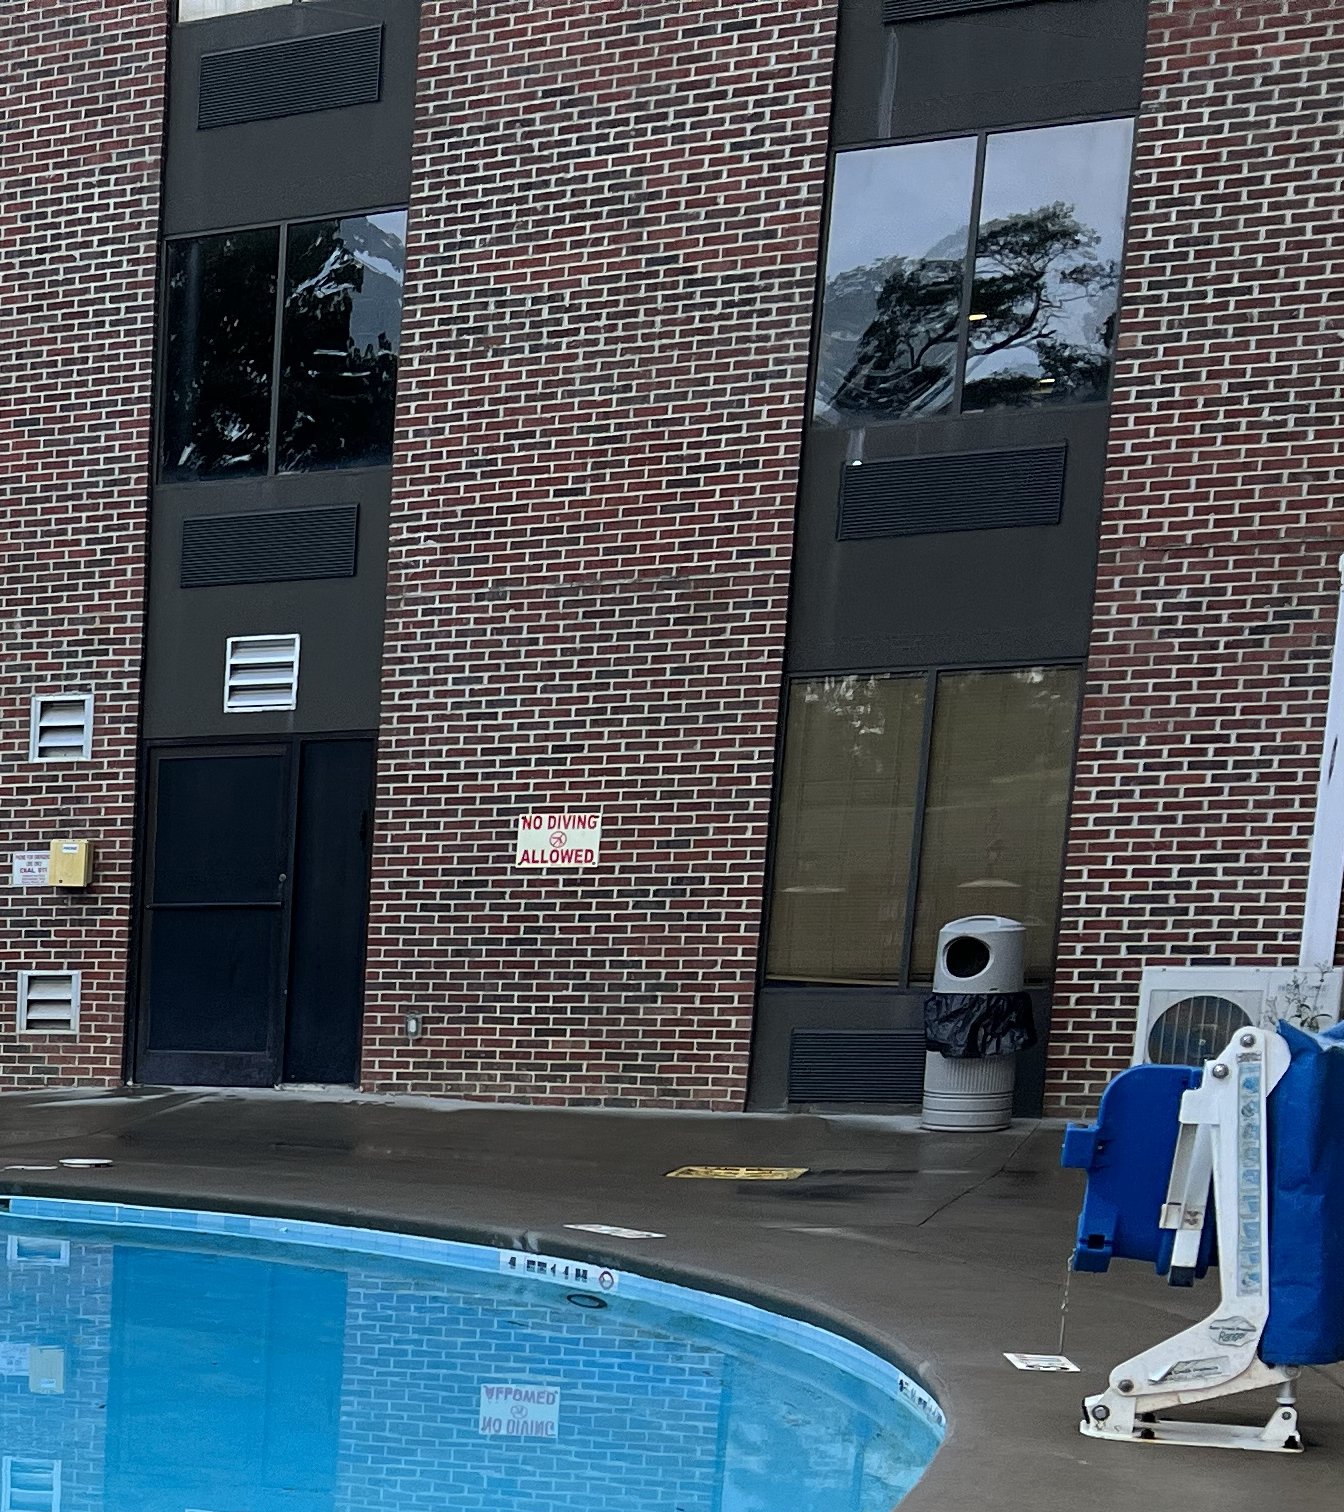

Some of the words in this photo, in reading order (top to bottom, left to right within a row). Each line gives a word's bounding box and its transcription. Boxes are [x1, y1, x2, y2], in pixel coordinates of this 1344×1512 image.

[522, 815, 542, 830] NO
[548, 815, 598, 830] DIVING
[520, 849, 594, 864] ALLOWED
